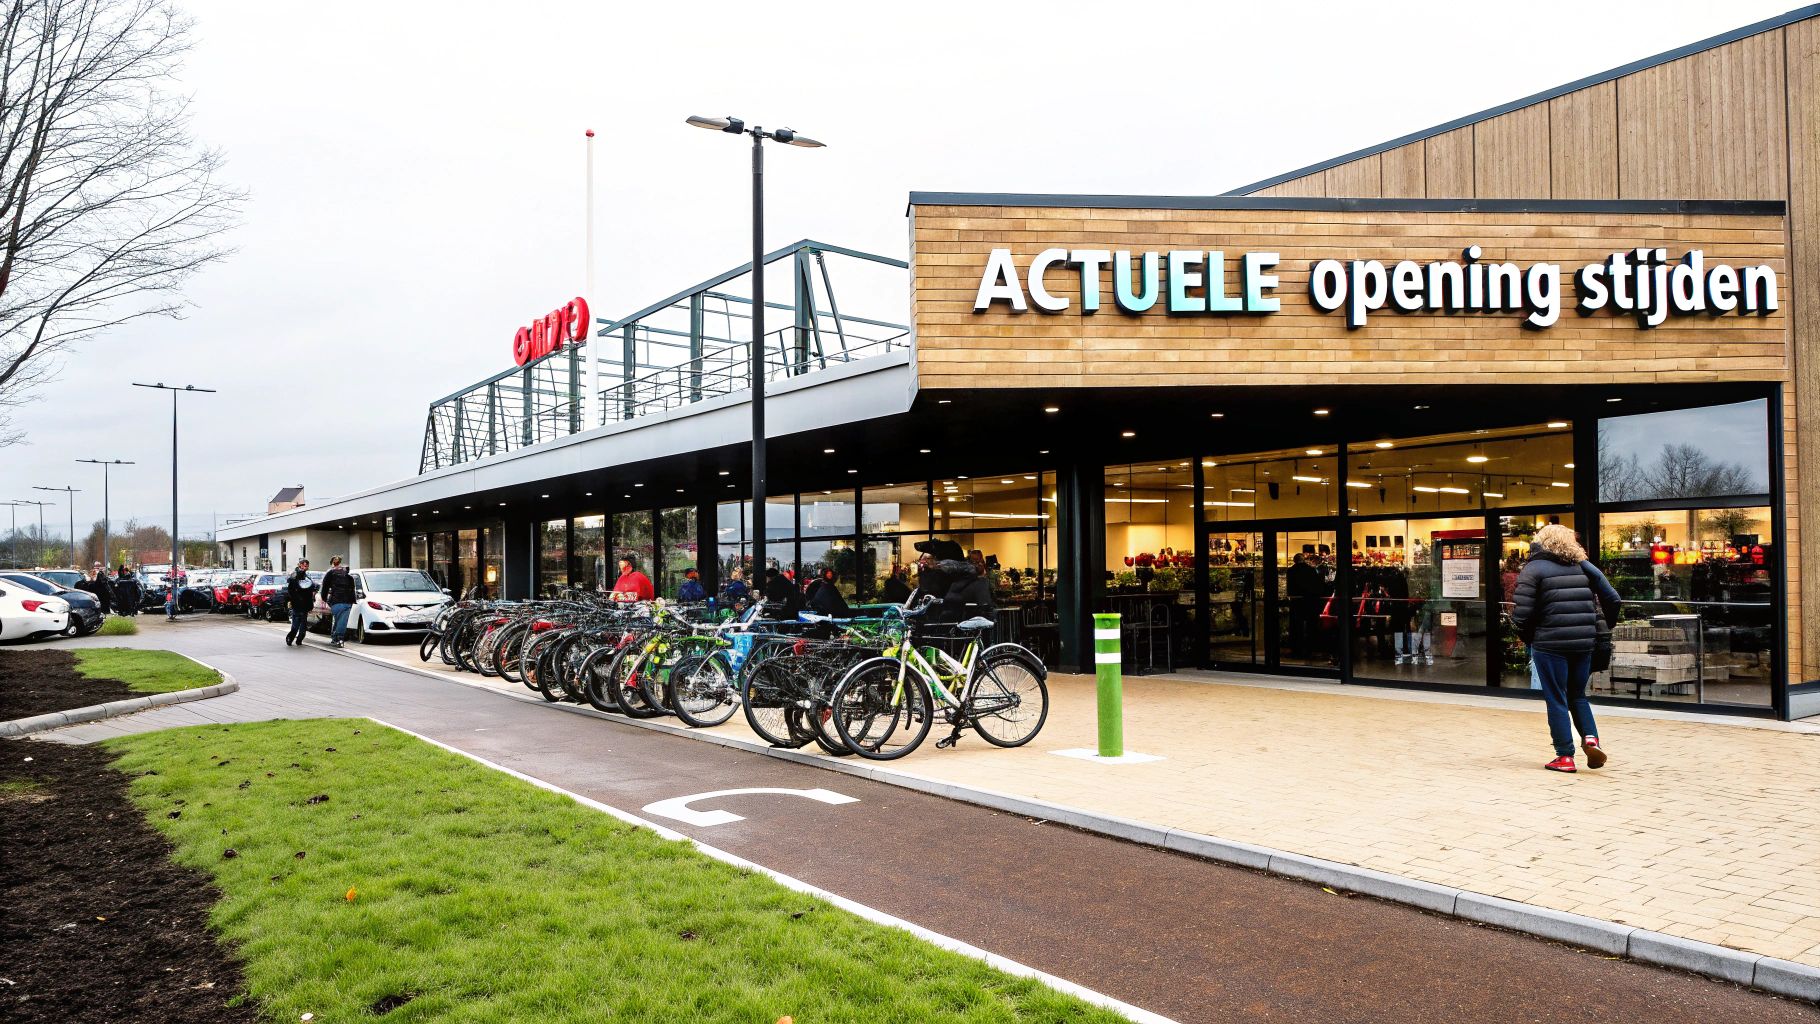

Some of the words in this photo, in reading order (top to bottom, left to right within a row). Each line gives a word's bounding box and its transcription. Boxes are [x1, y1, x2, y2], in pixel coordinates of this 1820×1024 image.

[973, 248, 1281, 312] ACTUELE
[1311, 245, 1561, 327] opening
[1580, 248, 1779, 327] stijden
